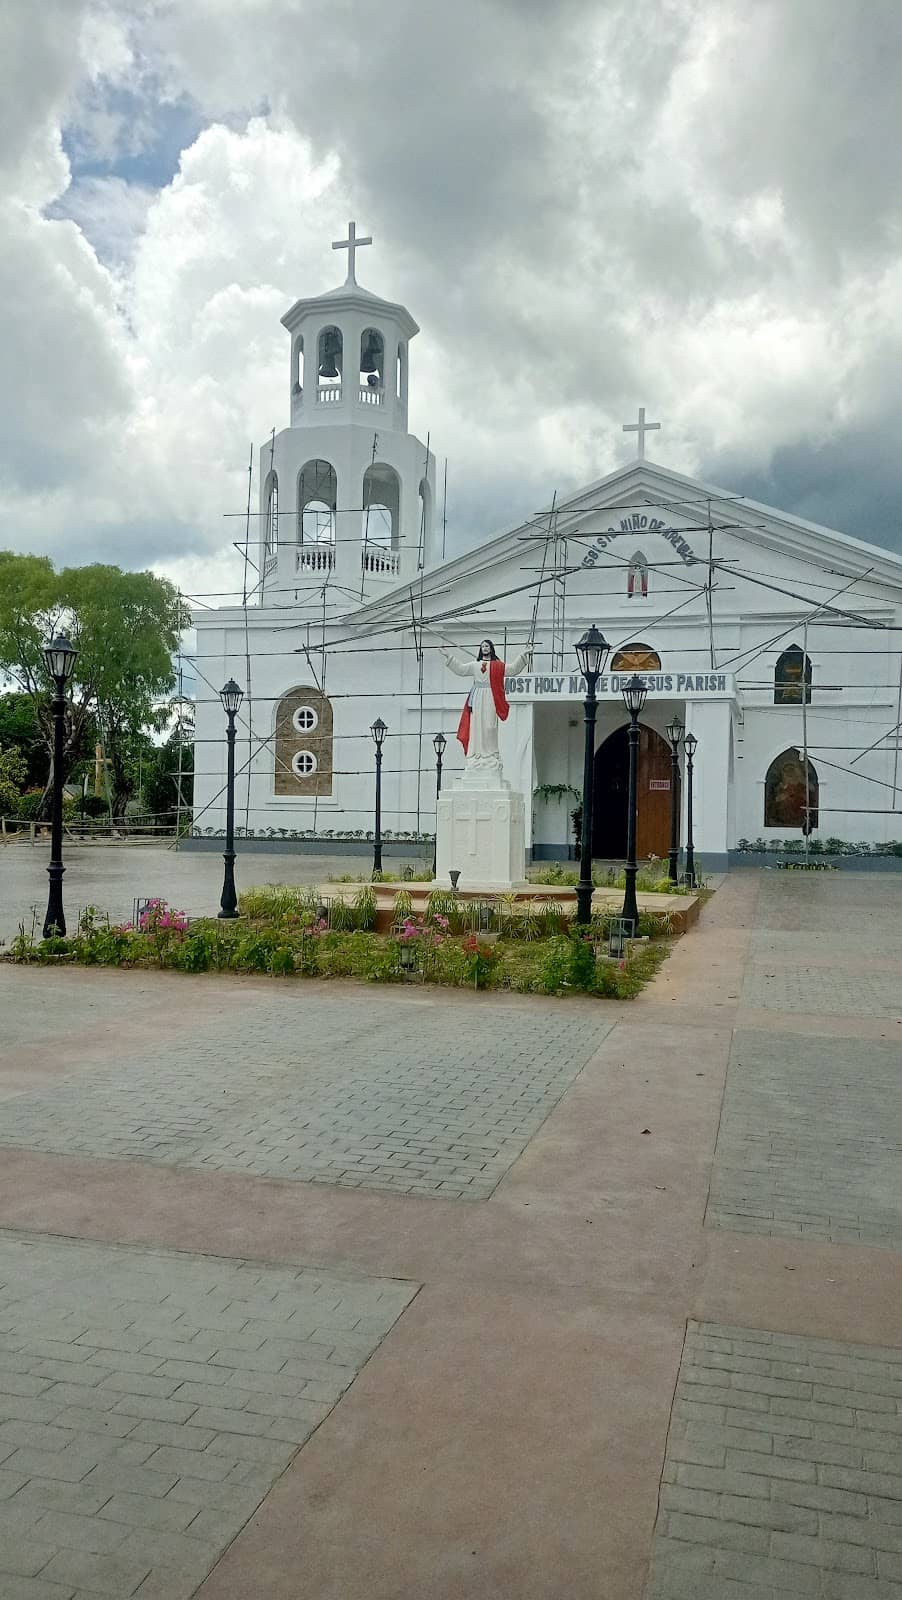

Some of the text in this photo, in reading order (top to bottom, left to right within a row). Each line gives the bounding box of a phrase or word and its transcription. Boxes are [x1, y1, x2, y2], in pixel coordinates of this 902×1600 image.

[620, 512, 648, 531] NIÑO
[648, 518, 666, 530] DE
[534, 677, 565, 694] HOLY
[611, 675, 628, 692] OF
[637, 675, 672, 692] ESUS
[677, 674, 726, 692] PARISH
